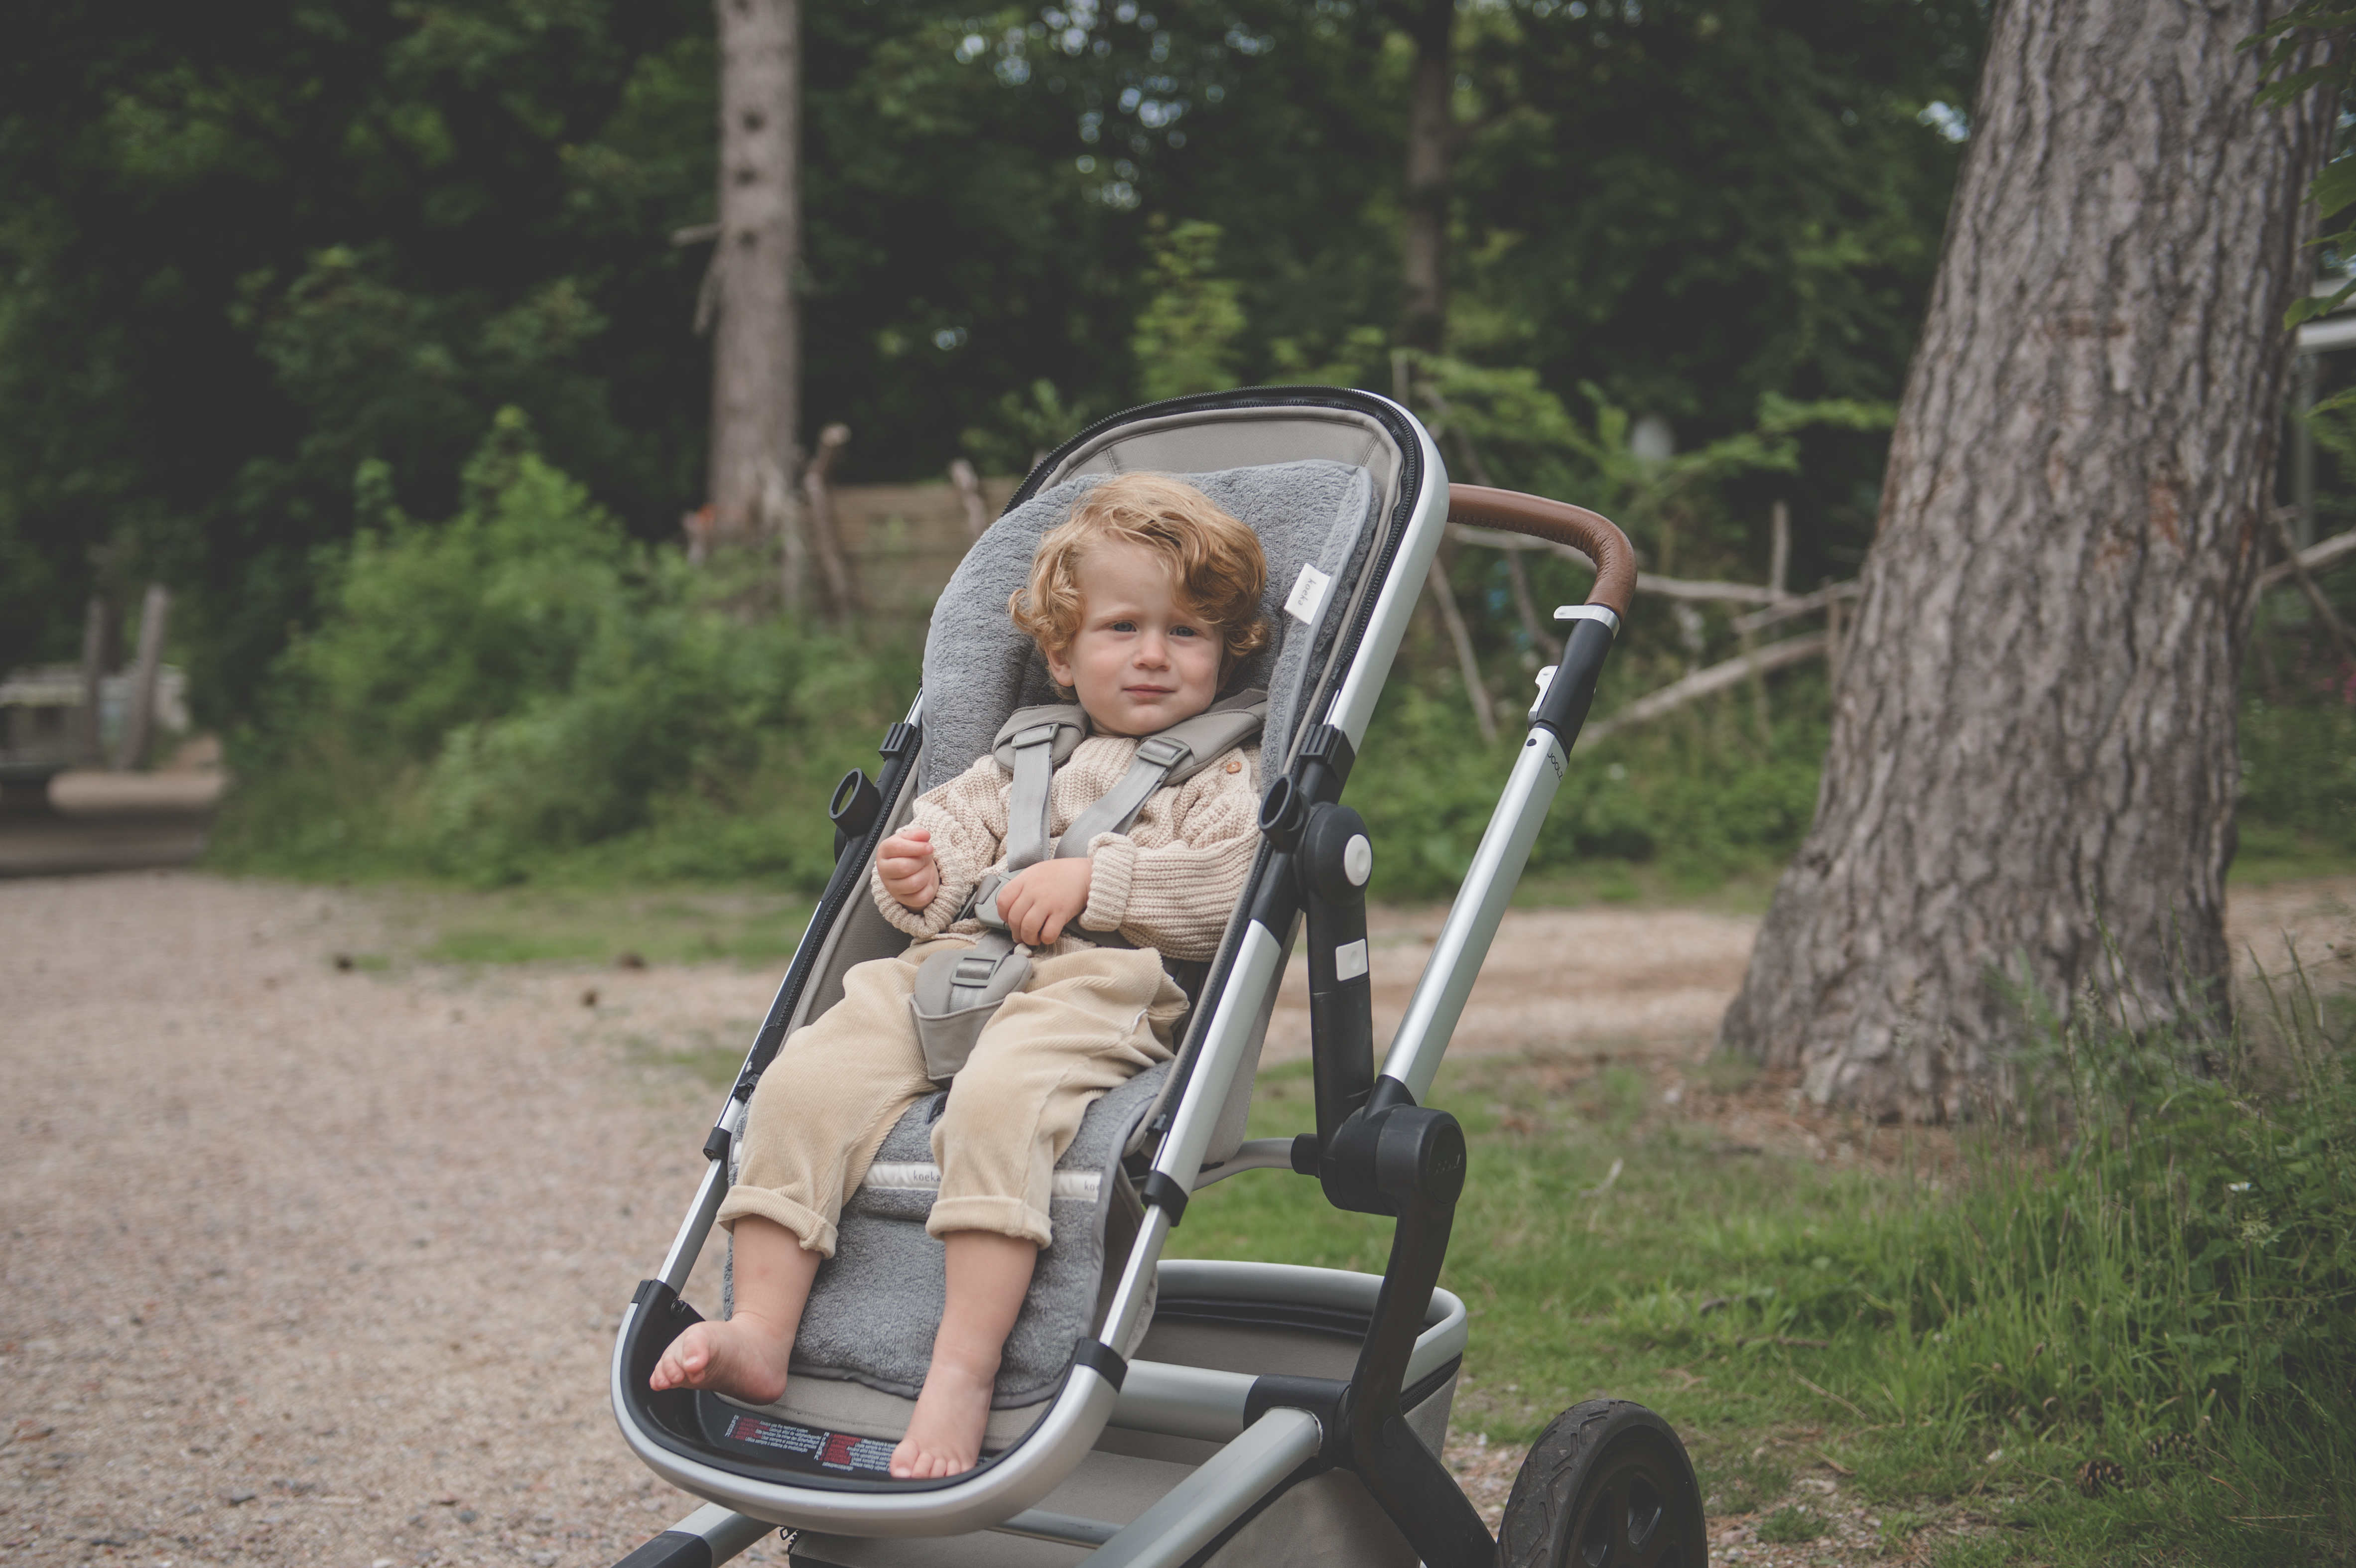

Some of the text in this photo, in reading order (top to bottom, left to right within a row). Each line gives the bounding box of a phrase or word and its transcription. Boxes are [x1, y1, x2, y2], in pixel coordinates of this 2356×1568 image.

[1297, 578, 1317, 606] koeka
[1547, 752, 1563, 782] JOOLZ
[913, 1170, 941, 1182] koeka
